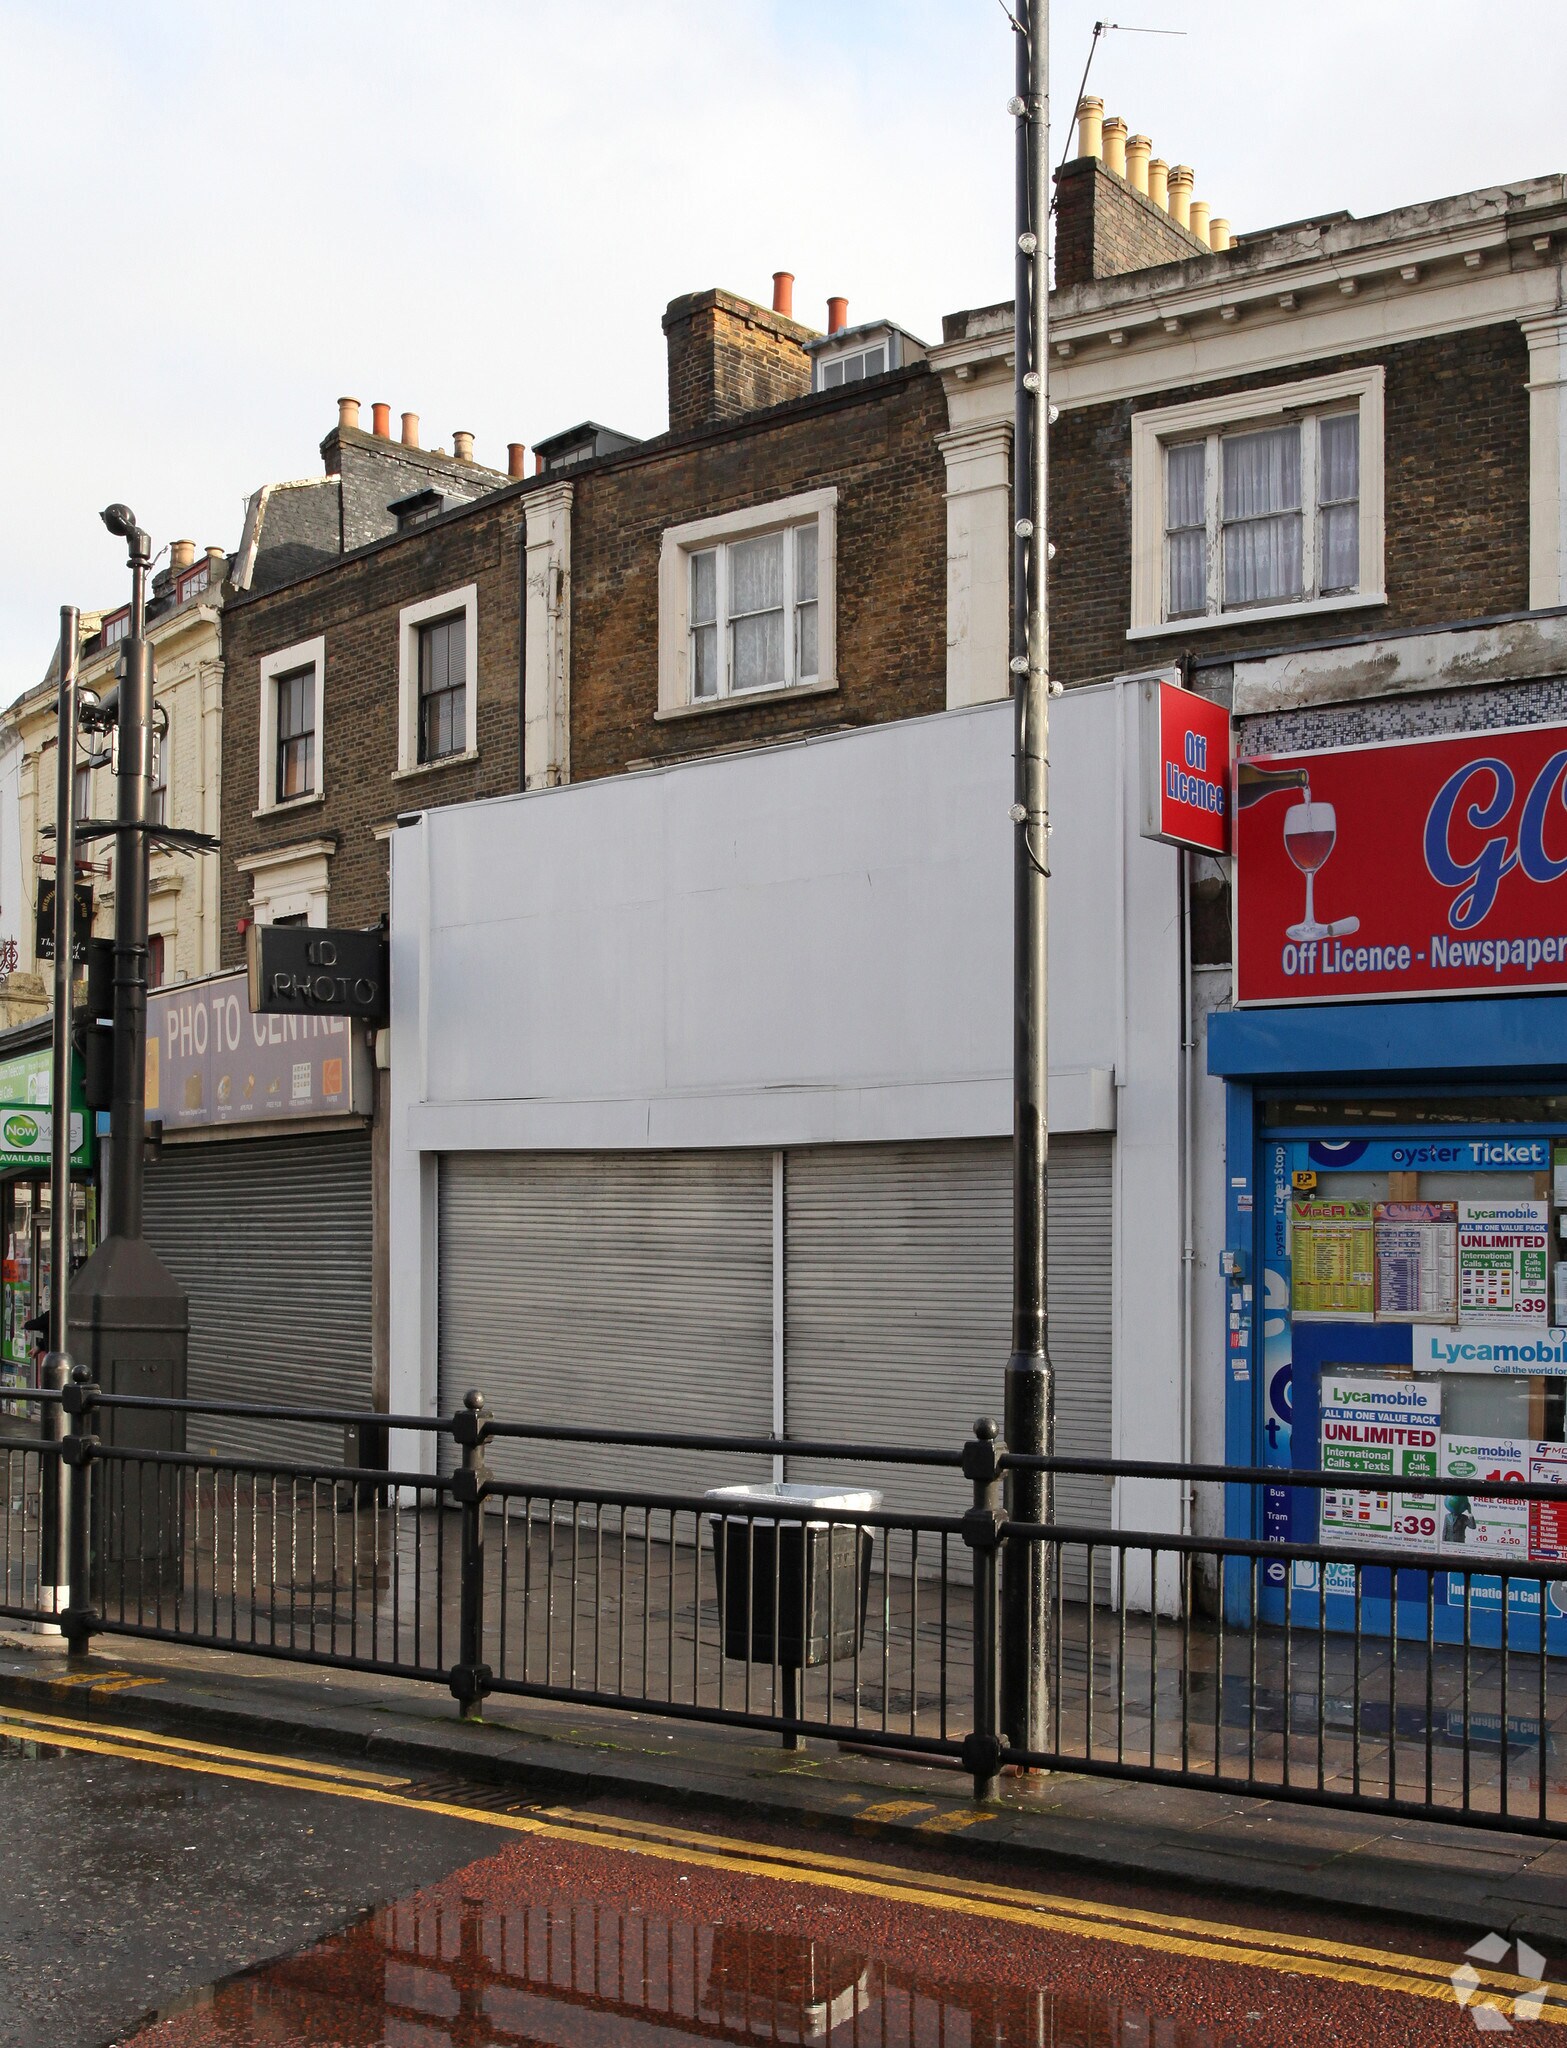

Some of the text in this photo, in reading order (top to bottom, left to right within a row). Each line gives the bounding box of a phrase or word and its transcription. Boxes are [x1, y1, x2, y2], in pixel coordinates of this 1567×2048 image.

[1185, 730, 1206, 772] Off
[1166, 760, 1225, 816] Licence
[307, 940, 338, 966] ID
[1282, 941, 1318, 976] Off
[1321, 942, 1411, 975] Licence
[1430, 935, 1567, 973] Newspaper
[271, 972, 378, 1004] PHOTO
[167, 995, 240, 1059] PHOTO
[6, 1125, 37, 1137] Now
[0, 1154, 52, 1163] AVAILABLE
[1274, 1146, 1286, 1175] Stop
[1392, 1142, 1543, 1167] oyster Ticket
[1467, 1208, 1538, 1220] Lycamobile
[1525, 1224, 1546, 1232] PACK
[1274, 1220, 1286, 1256] oyster
[1461, 1235, 1546, 1248] UNLIMITED
[1462, 1252, 1512, 1260] International
[1491, 1260, 1512, 1268] Texts
[1515, 1299, 1546, 1312] £39
[1493, 1365, 1511, 1373] Call
[1512, 1365, 1525, 1373] the
[1527, 1366, 1553, 1375] world
[1333, 1388, 1428, 1406] Lycamobile
[1324, 1409, 1437, 1424] ALL IN ONE VALUE PACK
[1325, 1424, 1436, 1447] UNLIMITED
[1326, 1447, 1391, 1460] International
[1448, 1442, 1522, 1457] Lycamobile
[1327, 1458, 1351, 1468] Calls
[1363, 1461, 1390, 1471] Texts
[1408, 1462, 1430, 1471] Calls
[1270, 1488, 1285, 1497] Bus
[1497, 1498, 1527, 1506] CREDIT
[1267, 1511, 1288, 1521] Tram
[1394, 1515, 1436, 1536] £39
[1325, 1563, 1355, 1577] yca
[1451, 1583, 1518, 1601] Intrnatioal
